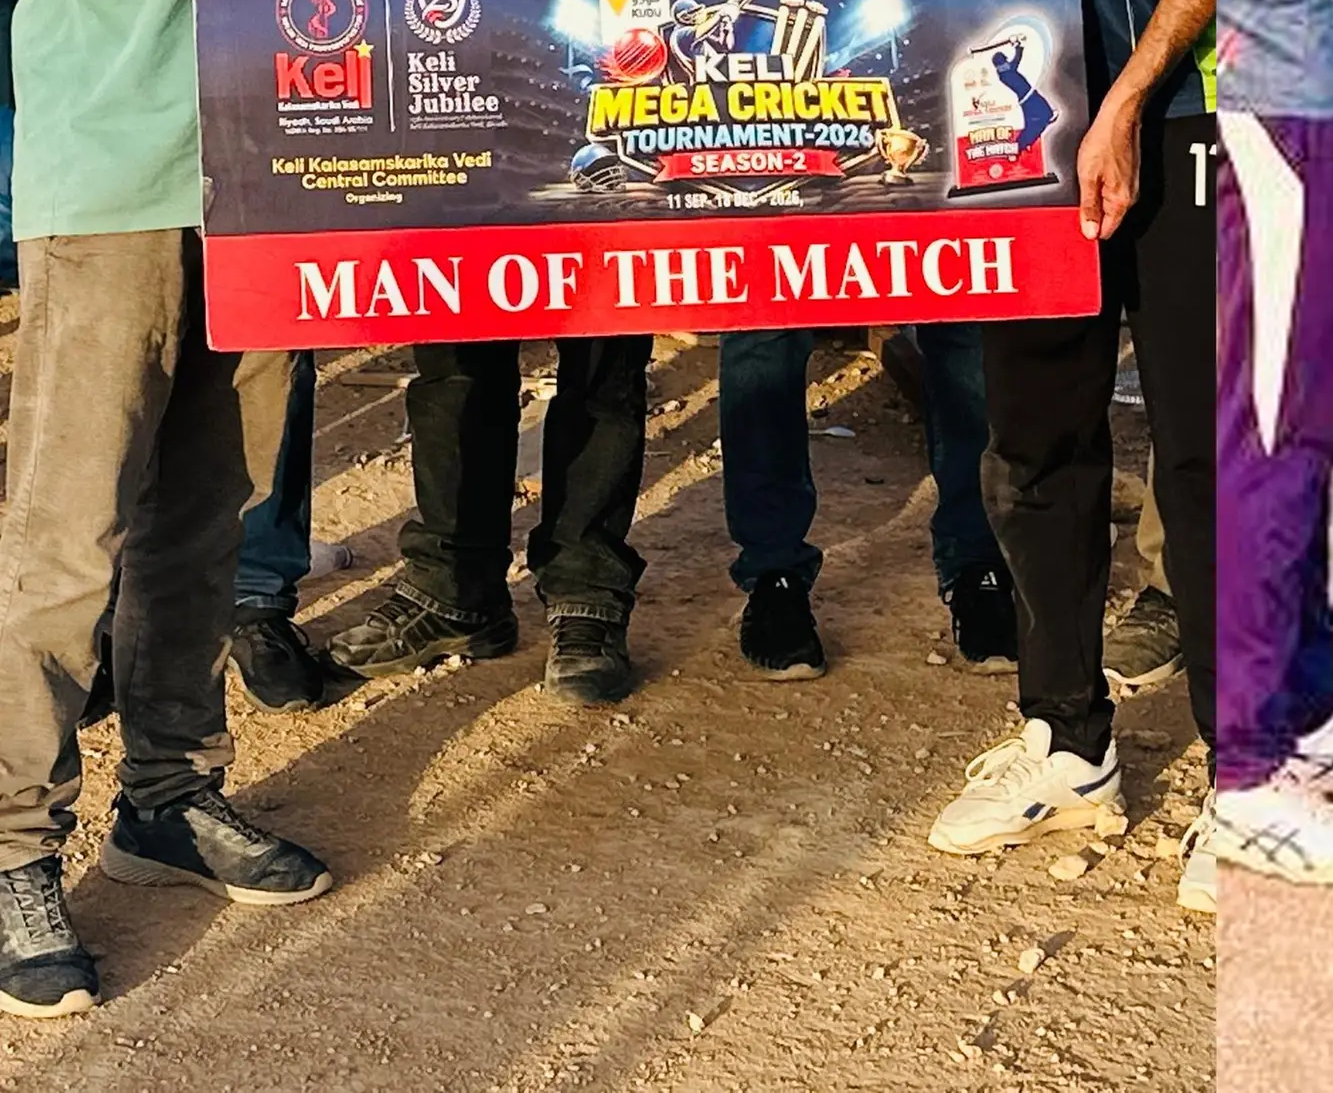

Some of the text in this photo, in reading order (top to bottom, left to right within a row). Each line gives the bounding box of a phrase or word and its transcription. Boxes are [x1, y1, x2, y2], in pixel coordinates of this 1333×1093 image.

[407, 50, 456, 73] Keli
[695, 52, 795, 84] KELI
[275, 49, 373, 110] Keli
[408, 73, 481, 94] Silver
[408, 93, 499, 115] Jubilee
[593, 81, 890, 129] MEGA CRICKET
[622, 122, 874, 154] TOURNAMENT-2026
[271, 151, 492, 174] Keli Kalasamskarika Vedi
[690, 151, 807, 174] SEASON-2
[1189, 143, 1216, 206] 1
[301, 170, 468, 190] Central Committee
[295, 237, 1019, 321] MAN OF THE MATCH
